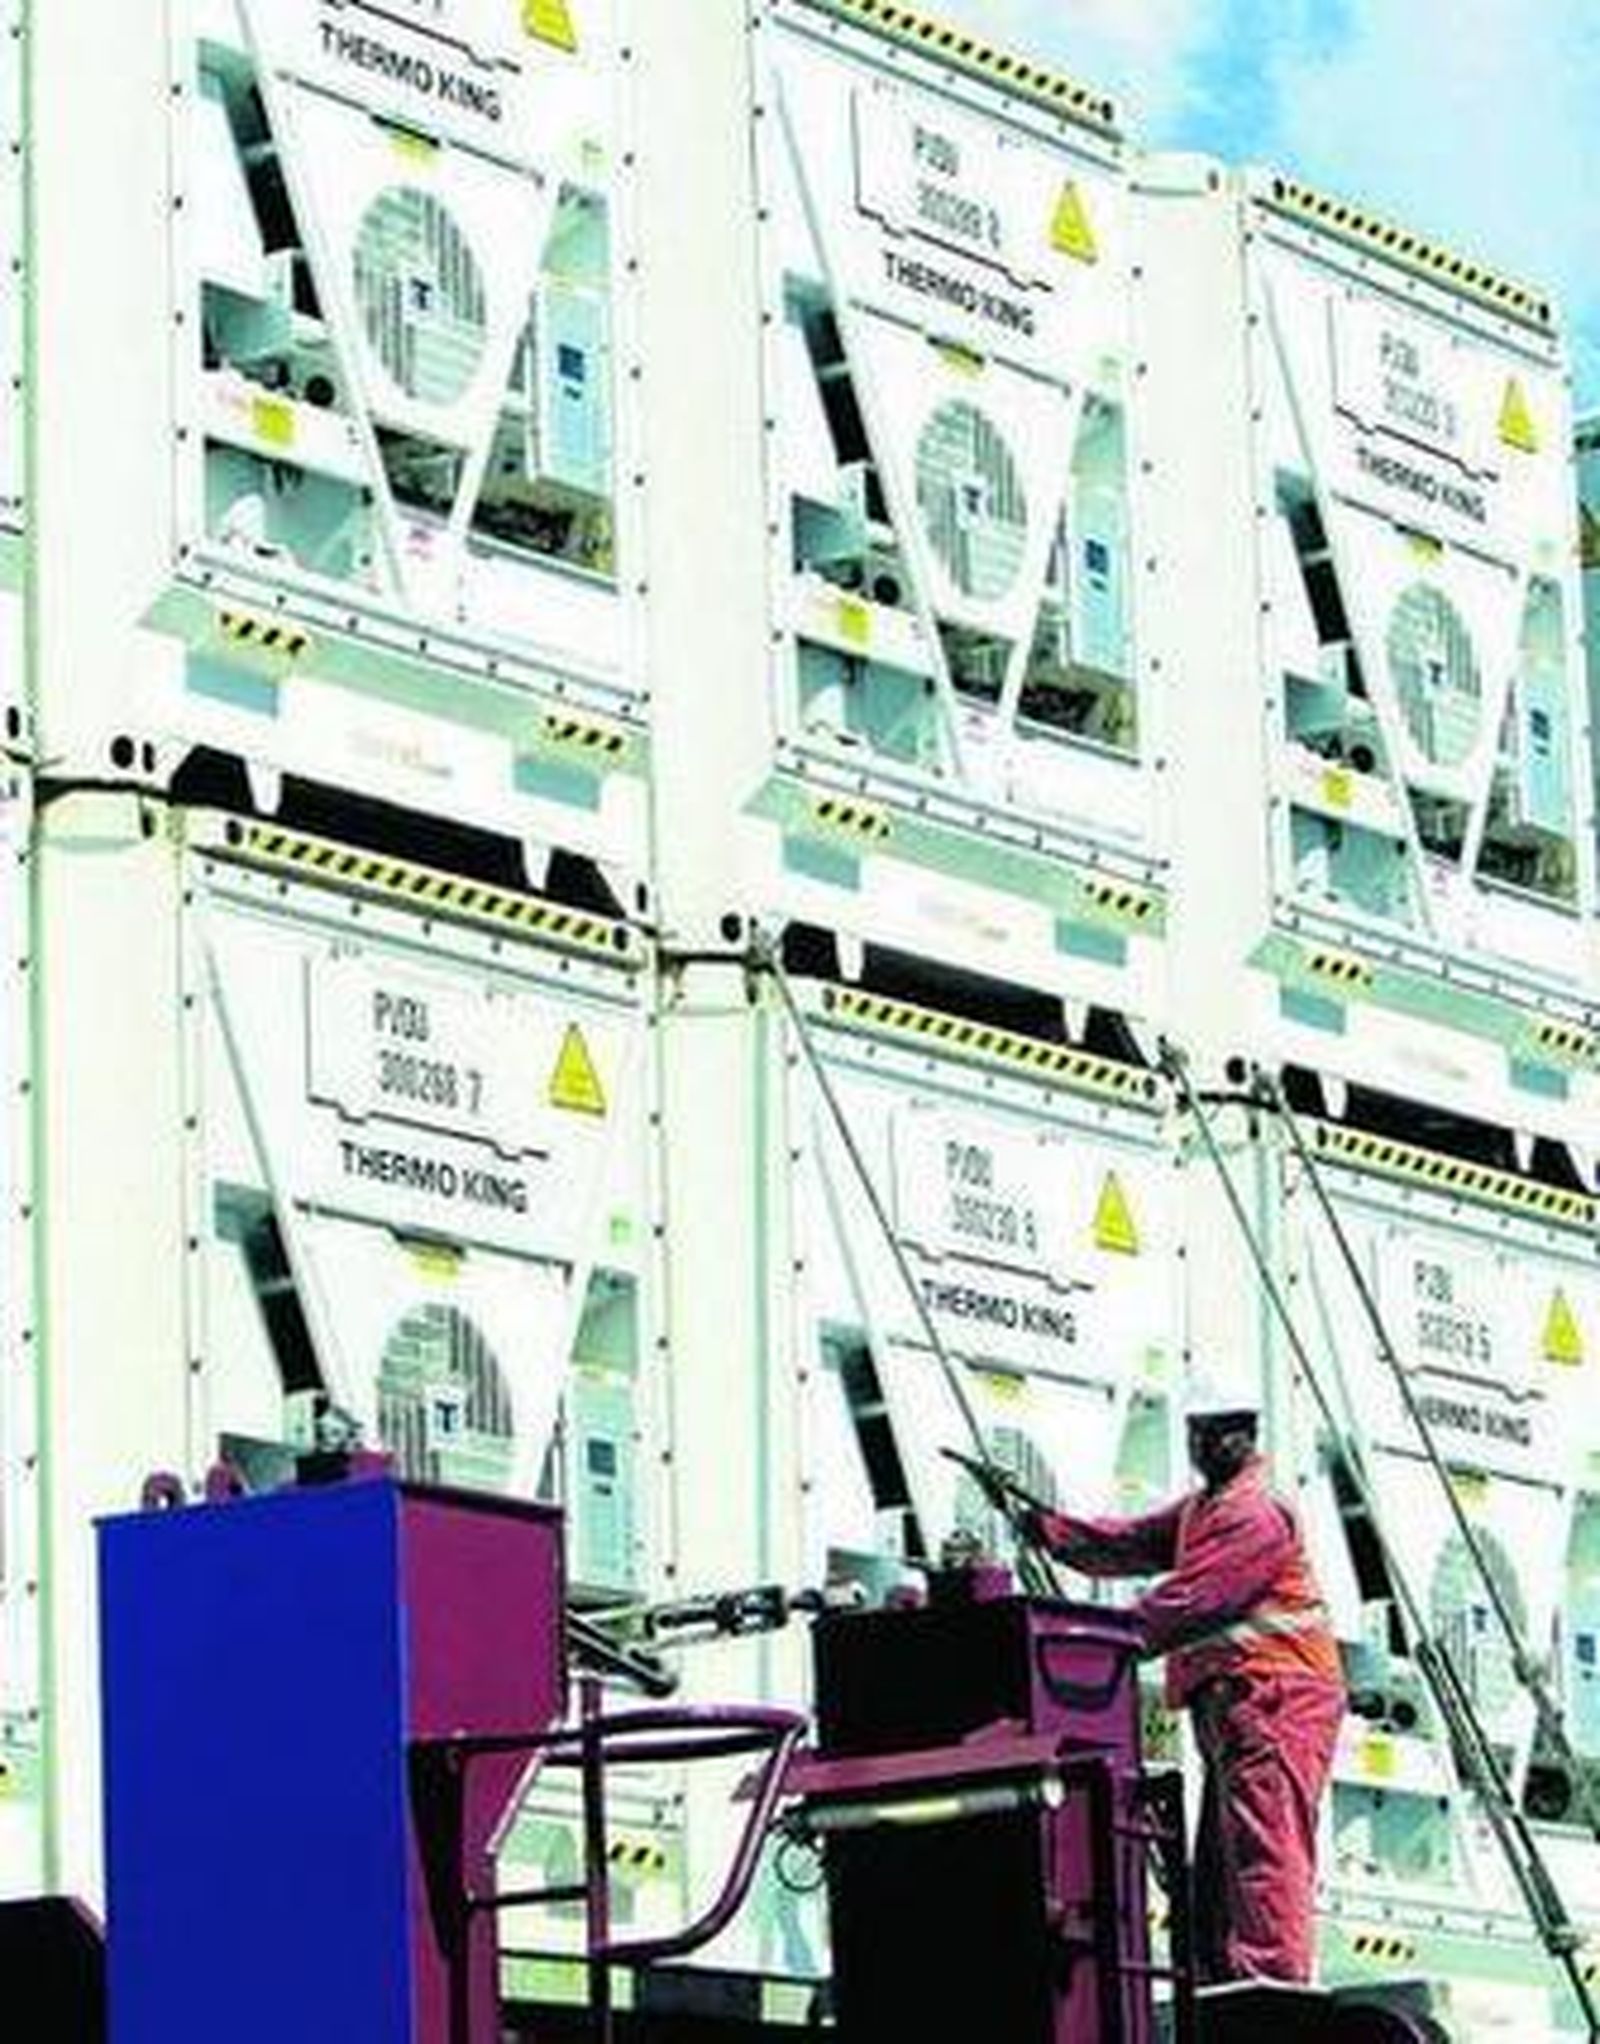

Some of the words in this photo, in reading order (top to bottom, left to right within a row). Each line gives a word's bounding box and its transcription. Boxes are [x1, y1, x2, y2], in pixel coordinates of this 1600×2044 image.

[319, 21, 432, 94] THERMO
[438, 70, 502, 121] KING
[883, 250, 975, 313] THERMO
[979, 291, 1035, 337] KING
[1355, 445, 1437, 502] THERMO
[1441, 484, 1487, 525] KING
[339, 1140, 457, 1199] THERMO
[462, 1168, 528, 1214] KING
[921, 1278, 1018, 1329] THERMO
[1022, 1302, 1076, 1345] KING
[1485, 1410, 1531, 1448] KING
